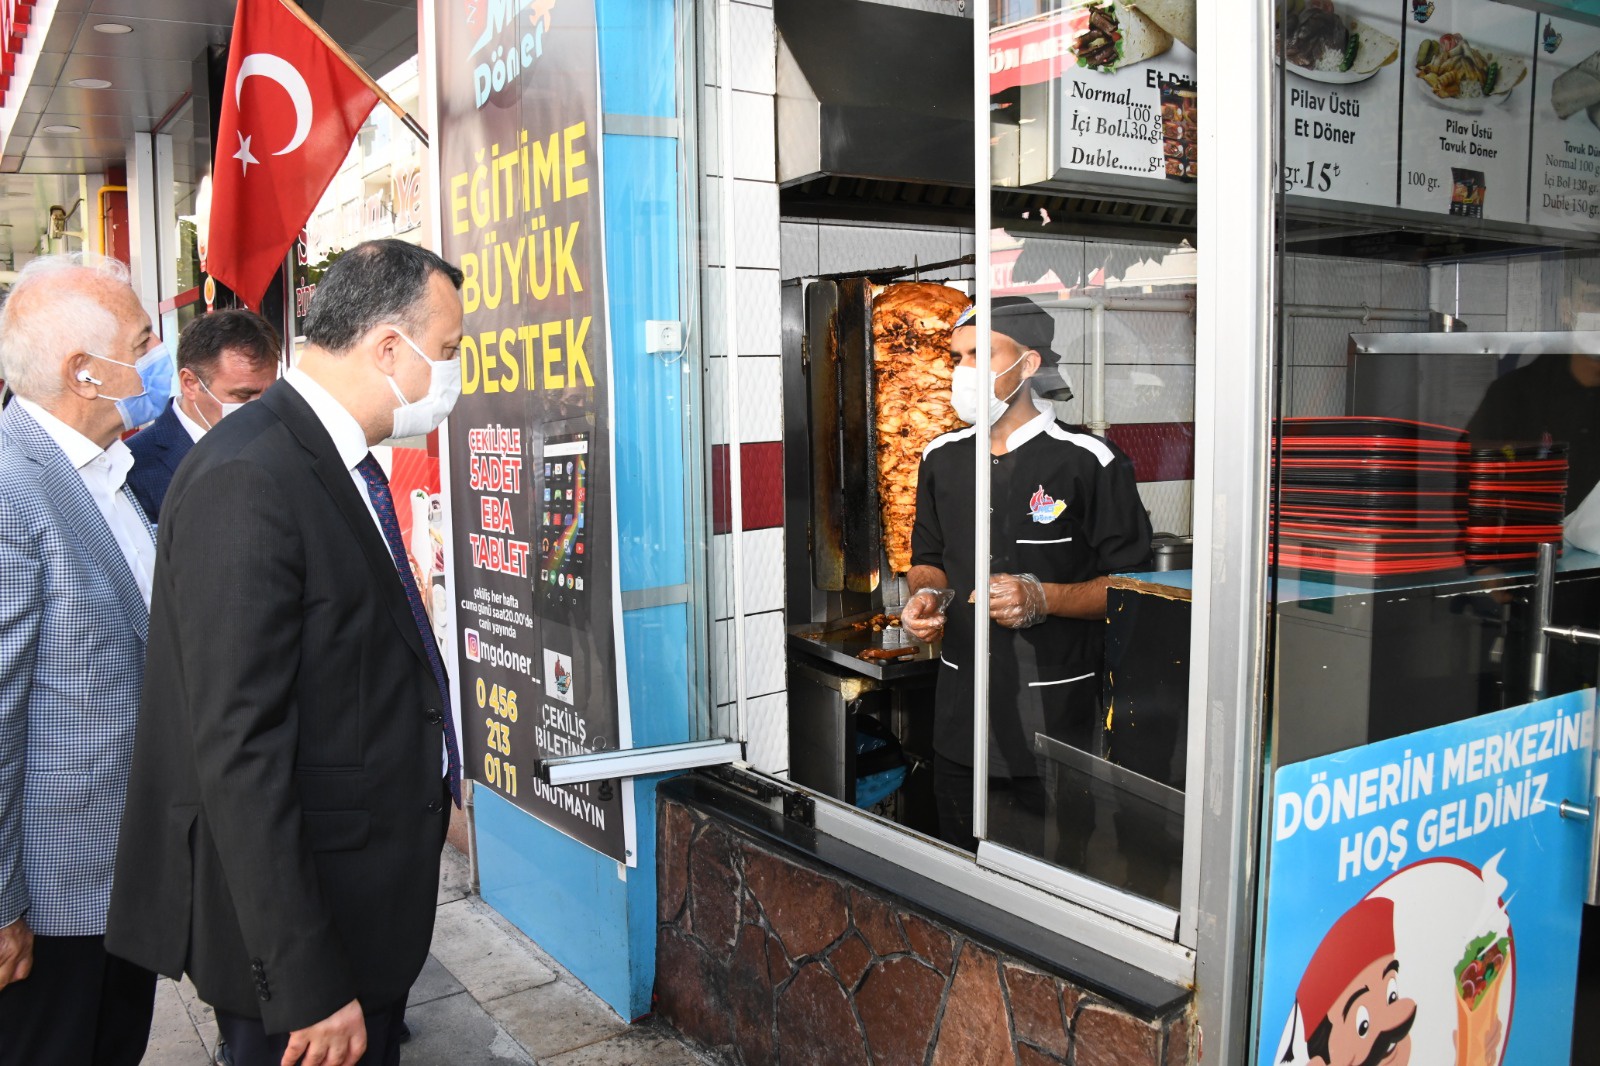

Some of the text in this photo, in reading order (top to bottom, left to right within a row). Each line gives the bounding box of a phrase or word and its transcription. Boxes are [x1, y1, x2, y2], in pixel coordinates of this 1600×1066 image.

[473, 21, 544, 109] Döner
[1126, 106, 1151, 122] 100
[1291, 88, 1360, 117] Pilav Üstü
[1070, 109, 1091, 137] İçi
[1294, 118, 1356, 144] Et Döner
[1446, 119, 1493, 139] Pilav Üstü
[1439, 137, 1498, 159] Tavuk Döner
[1564, 140, 1586, 155] Tavuk
[1545, 153, 1577, 170] Normal
[1579, 159, 1594, 172] 100
[451, 121, 588, 235] EĞİTİME
[1407, 171, 1441, 192] 100 gr.
[1557, 175, 1571, 189] Bol
[1573, 178, 1588, 191] 130
[1543, 193, 1570, 211] Duble
[1572, 198, 1588, 213] 150
[461, 215, 583, 315] BÜYÜK
[461, 316, 595, 395] DESTEK
[469, 424, 521, 457] ÇEKİLİŞLE
[480, 496, 514, 534] EBA
[469, 533, 529, 578] TABLET
[461, 600, 477, 611] cuma
[478, 602, 492, 616] günü
[491, 590, 502, 604] her
[502, 592, 519, 608] hafta
[492, 623, 517, 638] yayında
[476, 677, 486, 708] 0
[488, 683, 518, 723] 456
[485, 717, 511, 756] 213
[542, 704, 587, 745] ÇEKİLİŞ
[1276, 708, 1594, 842] DÖNERİN MERKEZİNE
[533, 776, 606, 831] UNUTMAYIN
[1338, 769, 1549, 882] HOŞ GELDİNİZ
